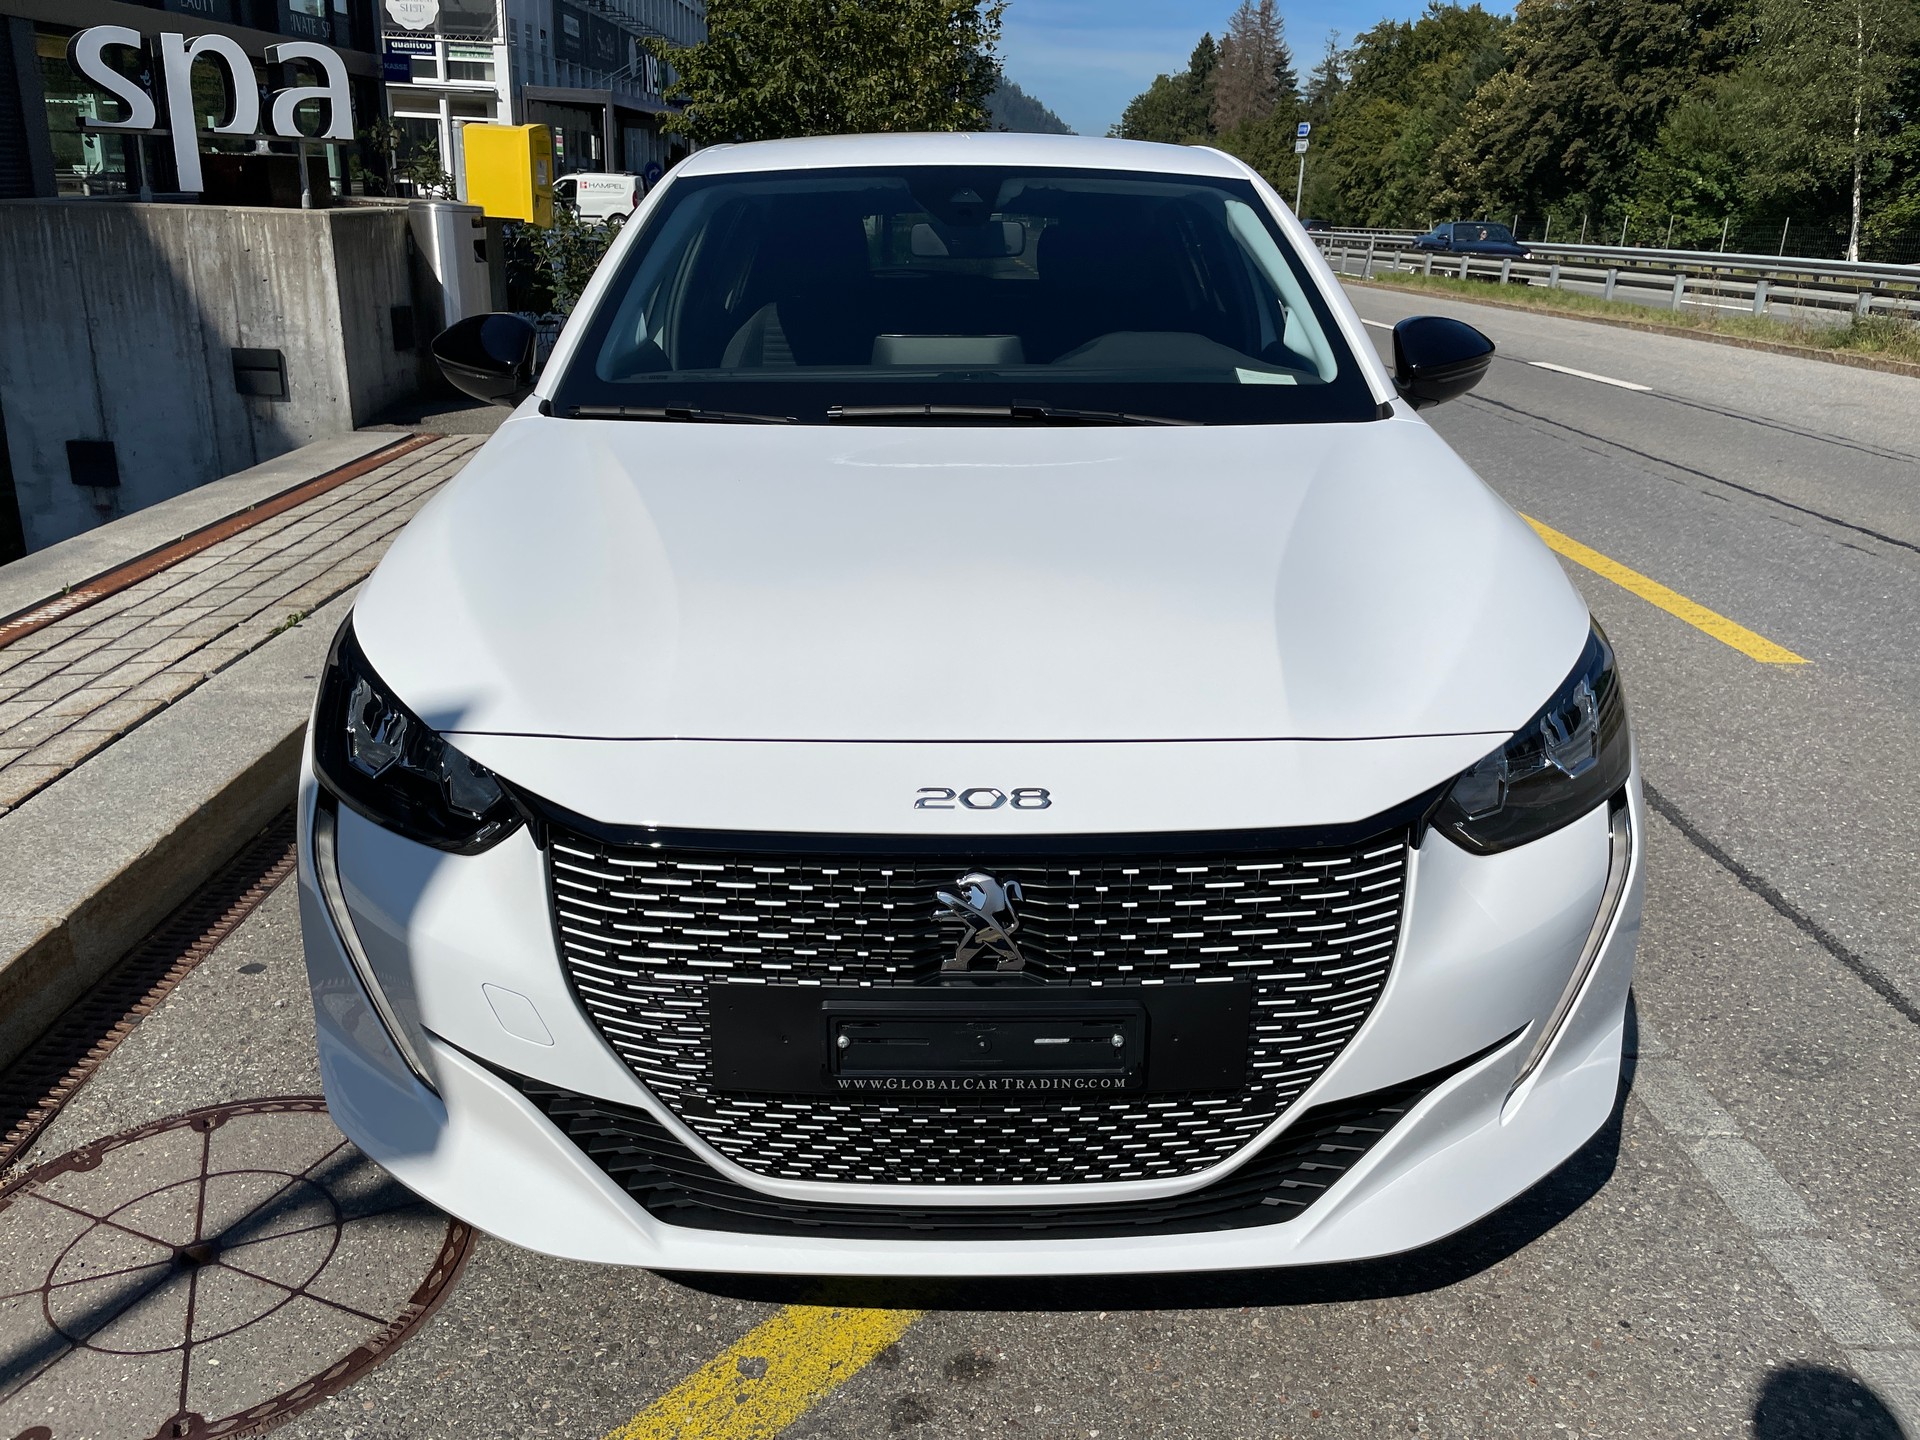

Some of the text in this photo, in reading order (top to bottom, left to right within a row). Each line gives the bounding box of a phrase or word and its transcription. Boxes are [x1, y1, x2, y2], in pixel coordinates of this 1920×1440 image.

[66, 24, 355, 192] spa
[588, 182, 624, 190] HAMPEL
[913, 787, 1052, 810] 208
